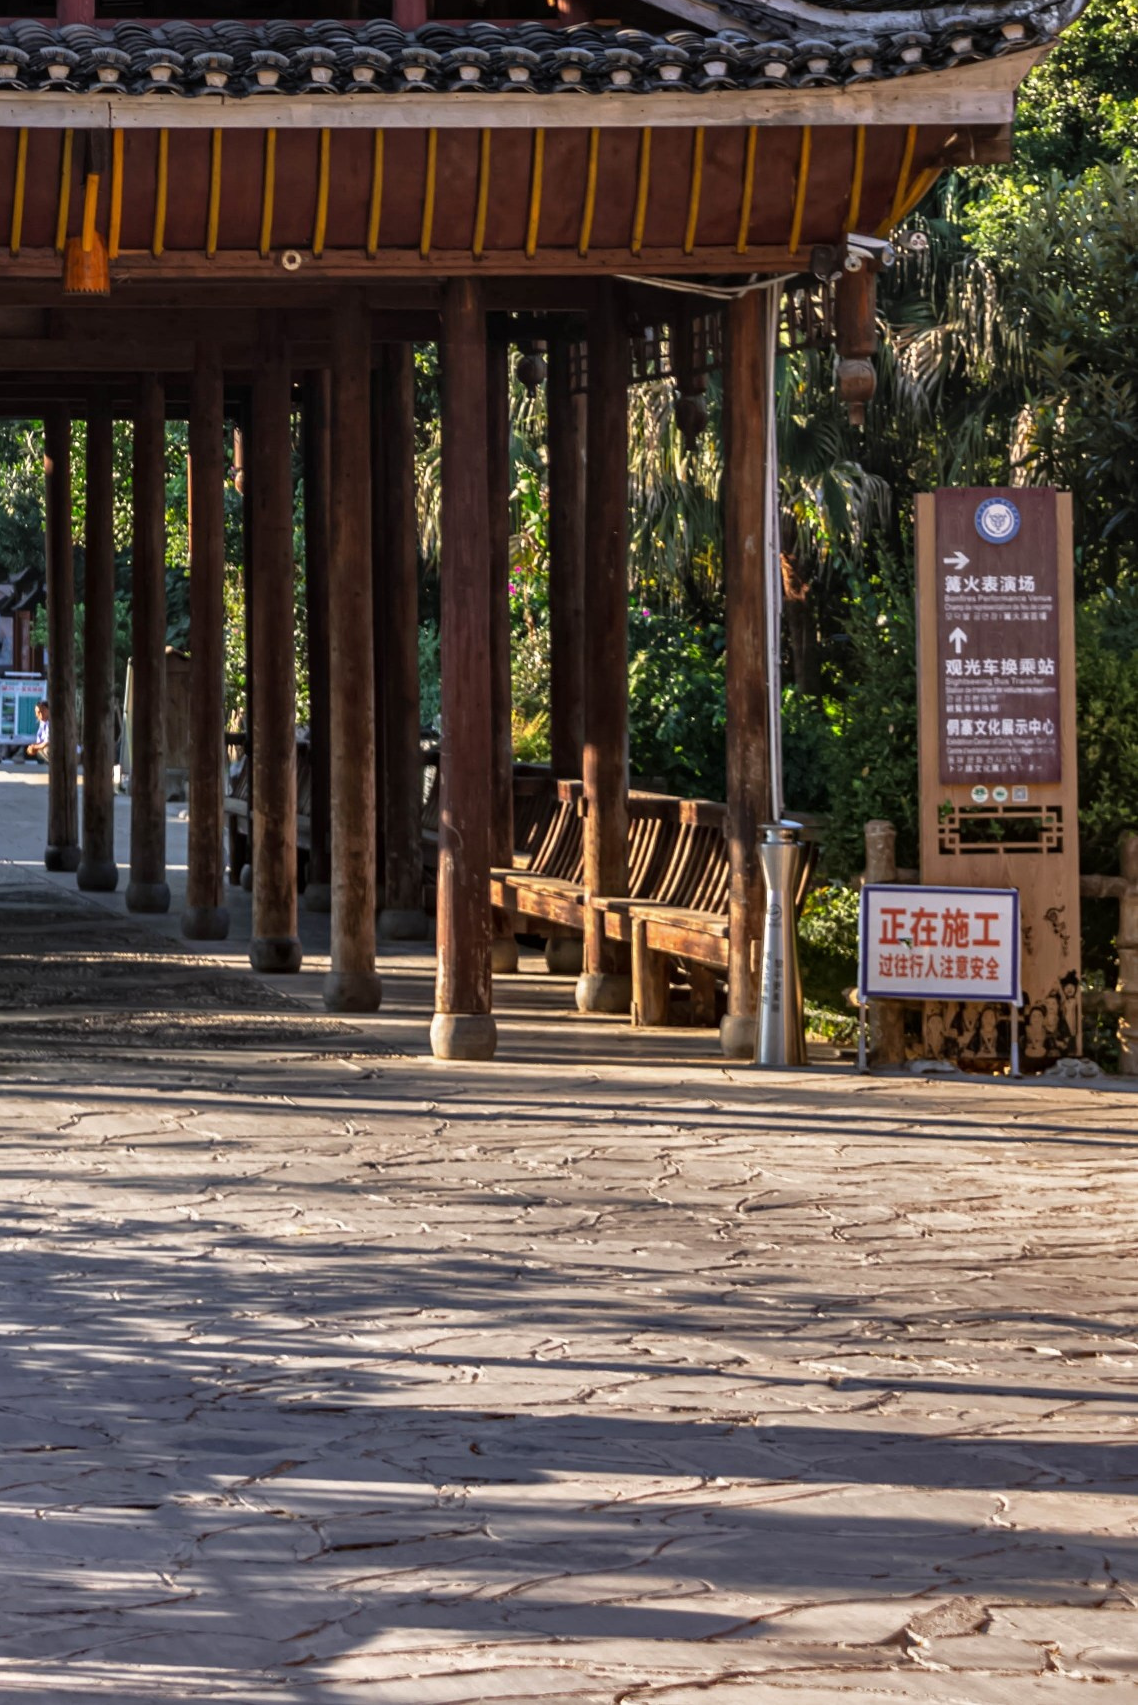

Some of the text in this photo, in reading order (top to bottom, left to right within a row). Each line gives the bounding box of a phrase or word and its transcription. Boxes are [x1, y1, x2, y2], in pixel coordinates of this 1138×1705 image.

[944, 575, 1035, 593] 篝火表演场
[945, 658, 1055, 676] 观光车换乘站
[946, 718, 1055, 736] 侗寨文化展示中心
[879, 906, 1000, 949] 正在施工
[879, 953, 999, 981] 过往行人注意安全
